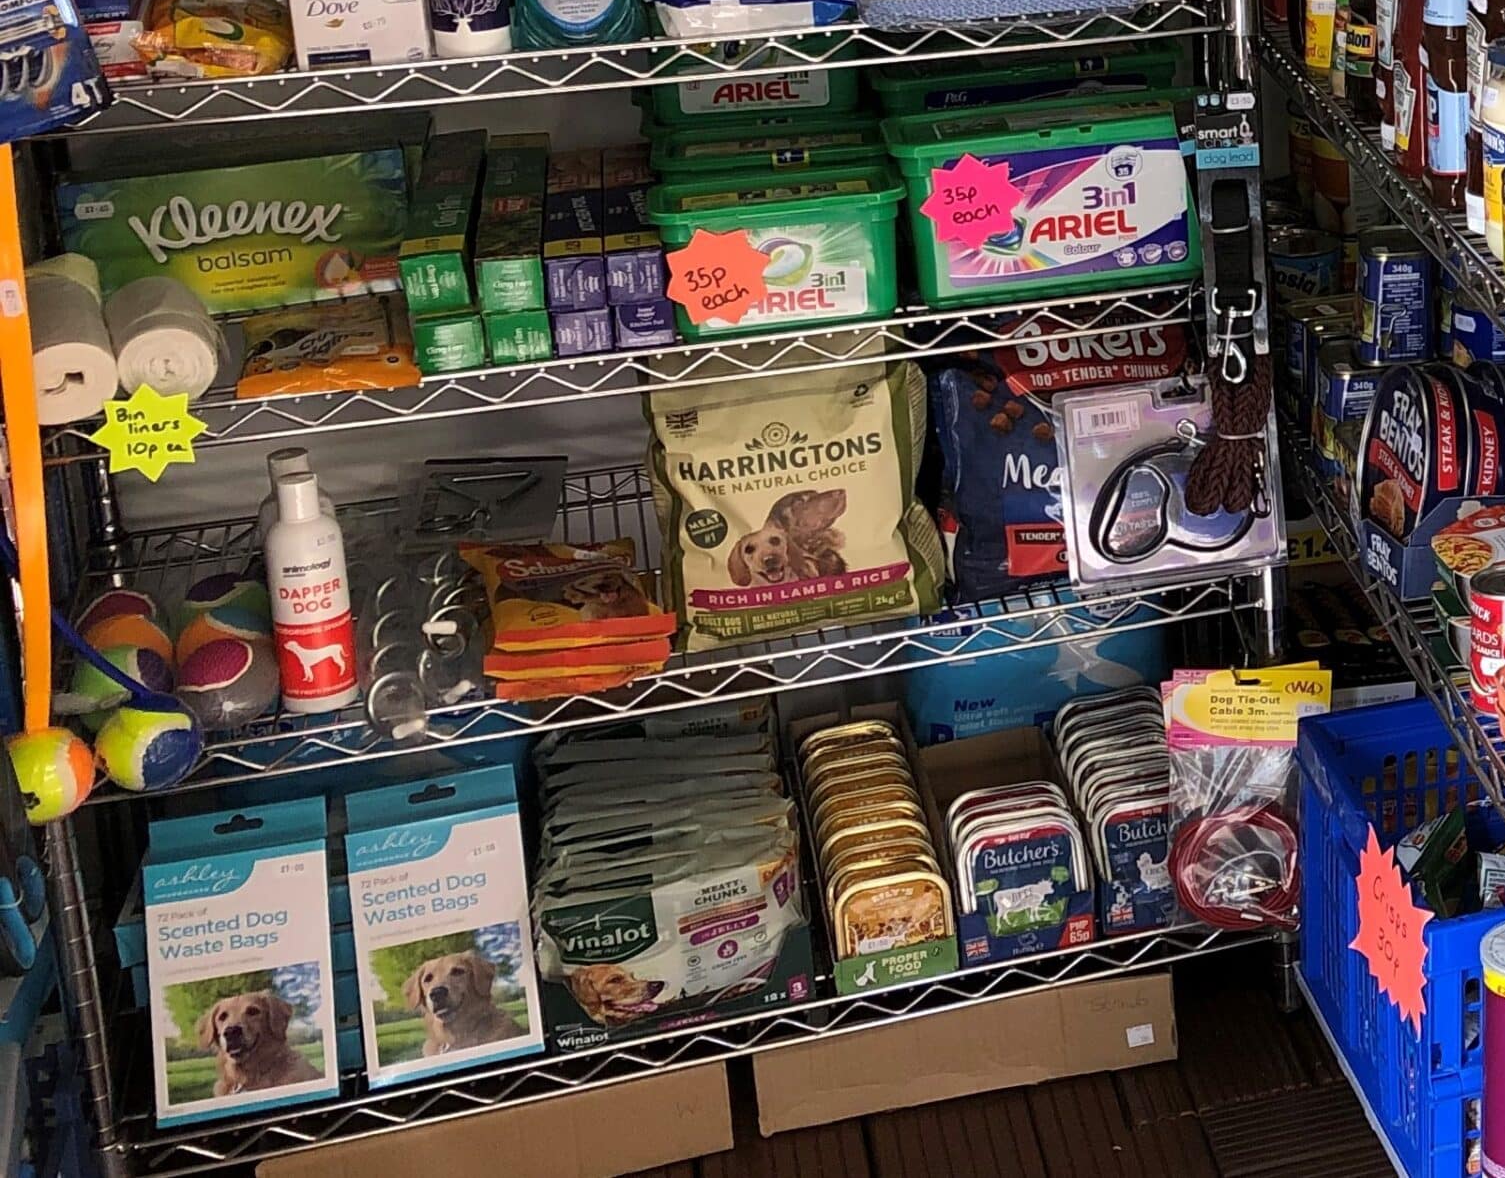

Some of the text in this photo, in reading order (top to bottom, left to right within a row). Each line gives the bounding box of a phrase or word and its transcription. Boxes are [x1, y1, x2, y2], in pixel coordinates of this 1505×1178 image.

[713, 80, 800, 105] ARIEL
[1198, 125, 1239, 140] smart
[1204, 151, 1255, 167] dog lead
[943, 186, 978, 206] 35p
[1082, 182, 1136, 210] 3in1
[952, 202, 1001, 225] each
[128, 196, 343, 263] Kleenex
[1030, 209, 1138, 244] ARIEL
[197, 245, 293, 274] balsam
[1063, 242, 1102, 256] Colour
[684, 267, 727, 293] 35p
[1392, 263, 1413, 273] 340g
[701, 284, 750, 311] each
[747, 289, 835, 316] ARIEL
[1123, 363, 1170, 378] CHUNKS
[116, 408, 146, 422] Bin
[128, 418, 180, 435] liners
[126, 441, 158, 462] 10p
[679, 432, 882, 482] HARRINGTONS
[1482, 425, 1494, 485] KIDNEY
[732, 460, 868, 494] NATURAL CHOICE
[279, 577, 341, 600] DAPPER
[708, 570, 891, 605] RICH IN LAMB RICE
[293, 597, 332, 614] DOG
[953, 696, 996, 713] New
[1209, 706, 1244, 716] Cable
[1210, 694, 1281, 705] Dog Tie-Out
[356, 827, 438, 859] ashley
[983, 840, 1062, 870] Butcher's
[153, 862, 243, 892] ashley
[361, 870, 488, 909] Scented Dog
[363, 891, 479, 927] Waste Bags
[158, 907, 289, 943] Scented Dog
[159, 928, 280, 961] Waste Bags
[881, 950, 928, 968] PROPER
[888, 959, 922, 974] FOOD
[557, 1030, 610, 1049] Winalot
